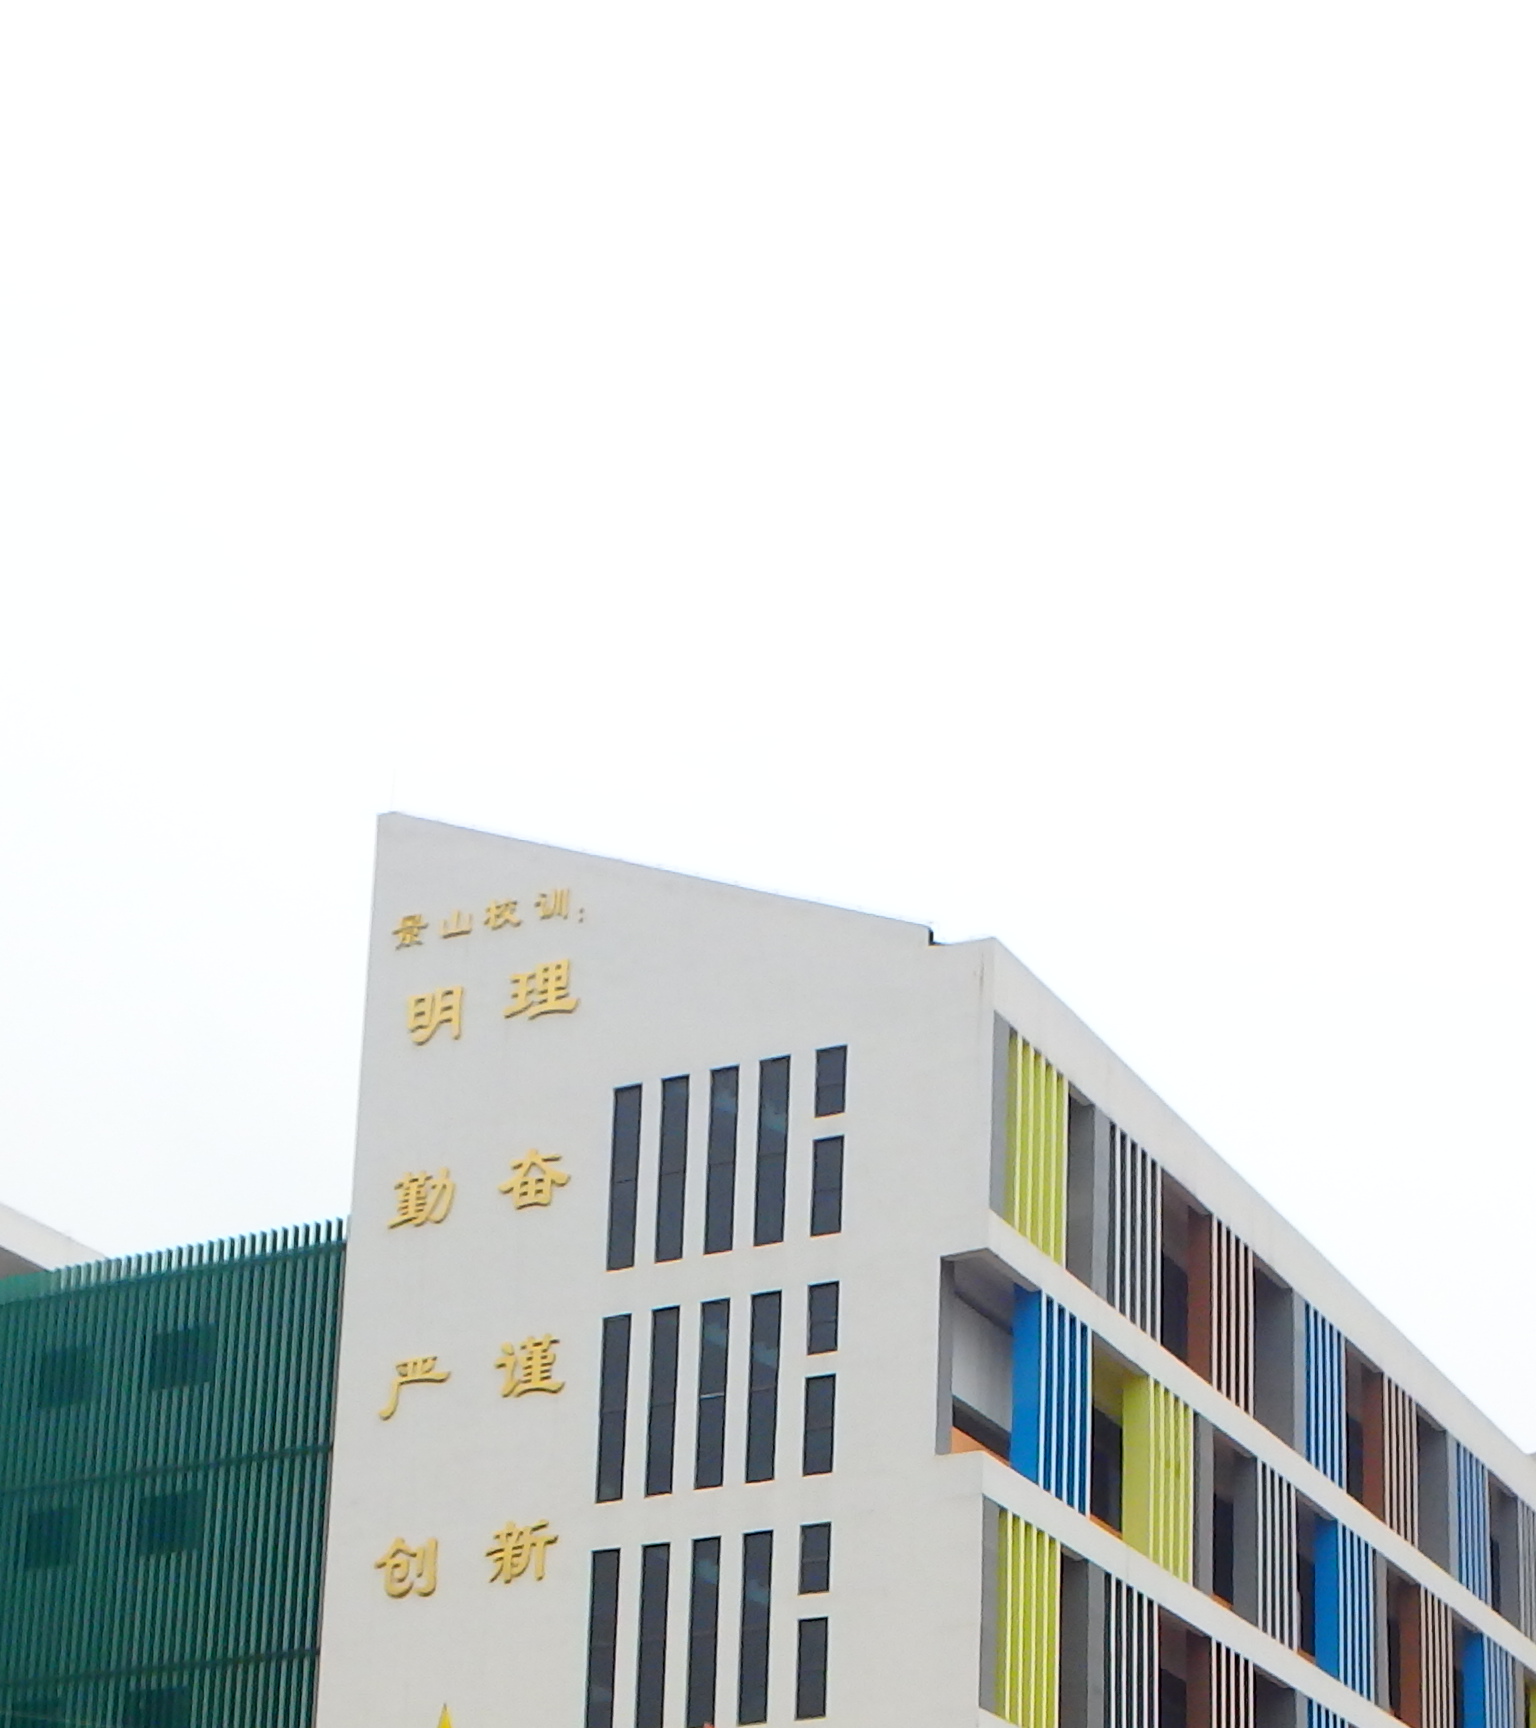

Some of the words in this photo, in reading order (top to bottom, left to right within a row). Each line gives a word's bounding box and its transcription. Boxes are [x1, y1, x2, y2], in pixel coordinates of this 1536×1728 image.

[407, 957, 581, 1047] 明理
[387, 1147, 572, 1231] 勤奋
[377, 1332, 566, 1422] 严谨
[373, 1519, 559, 1600] 创新
